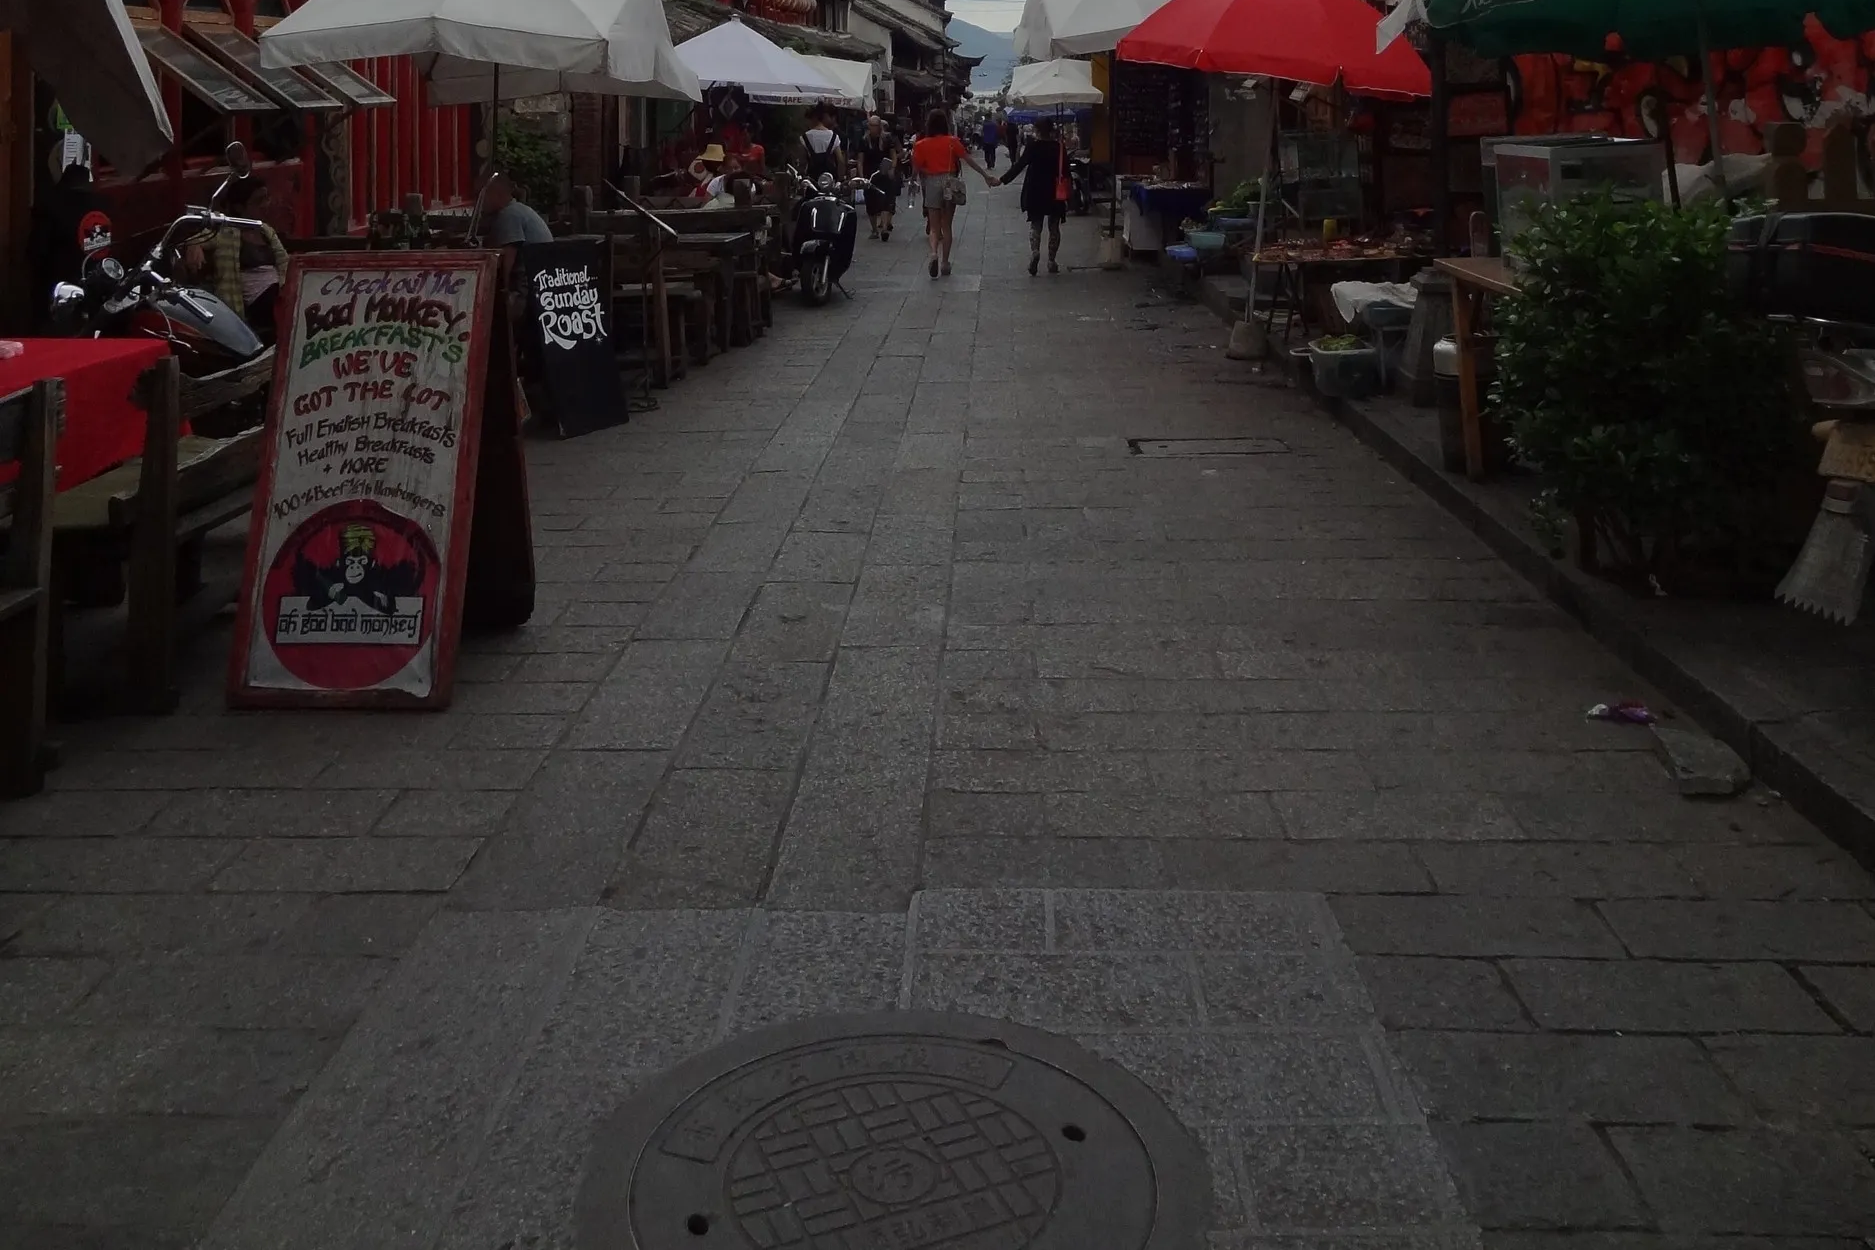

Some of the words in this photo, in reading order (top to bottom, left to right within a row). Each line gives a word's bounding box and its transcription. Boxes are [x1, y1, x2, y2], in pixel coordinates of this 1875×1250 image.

[320, 270, 391, 295] Check
[540, 284, 598, 310] Sunday
[538, 303, 608, 350] Roast
[333, 350, 418, 379] WE'VE
[293, 385, 338, 416] GOT
[343, 379, 394, 402] THE
[286, 423, 313, 449] Full
[340, 457, 389, 474] MORE
[360, 610, 421, 638] monkey
